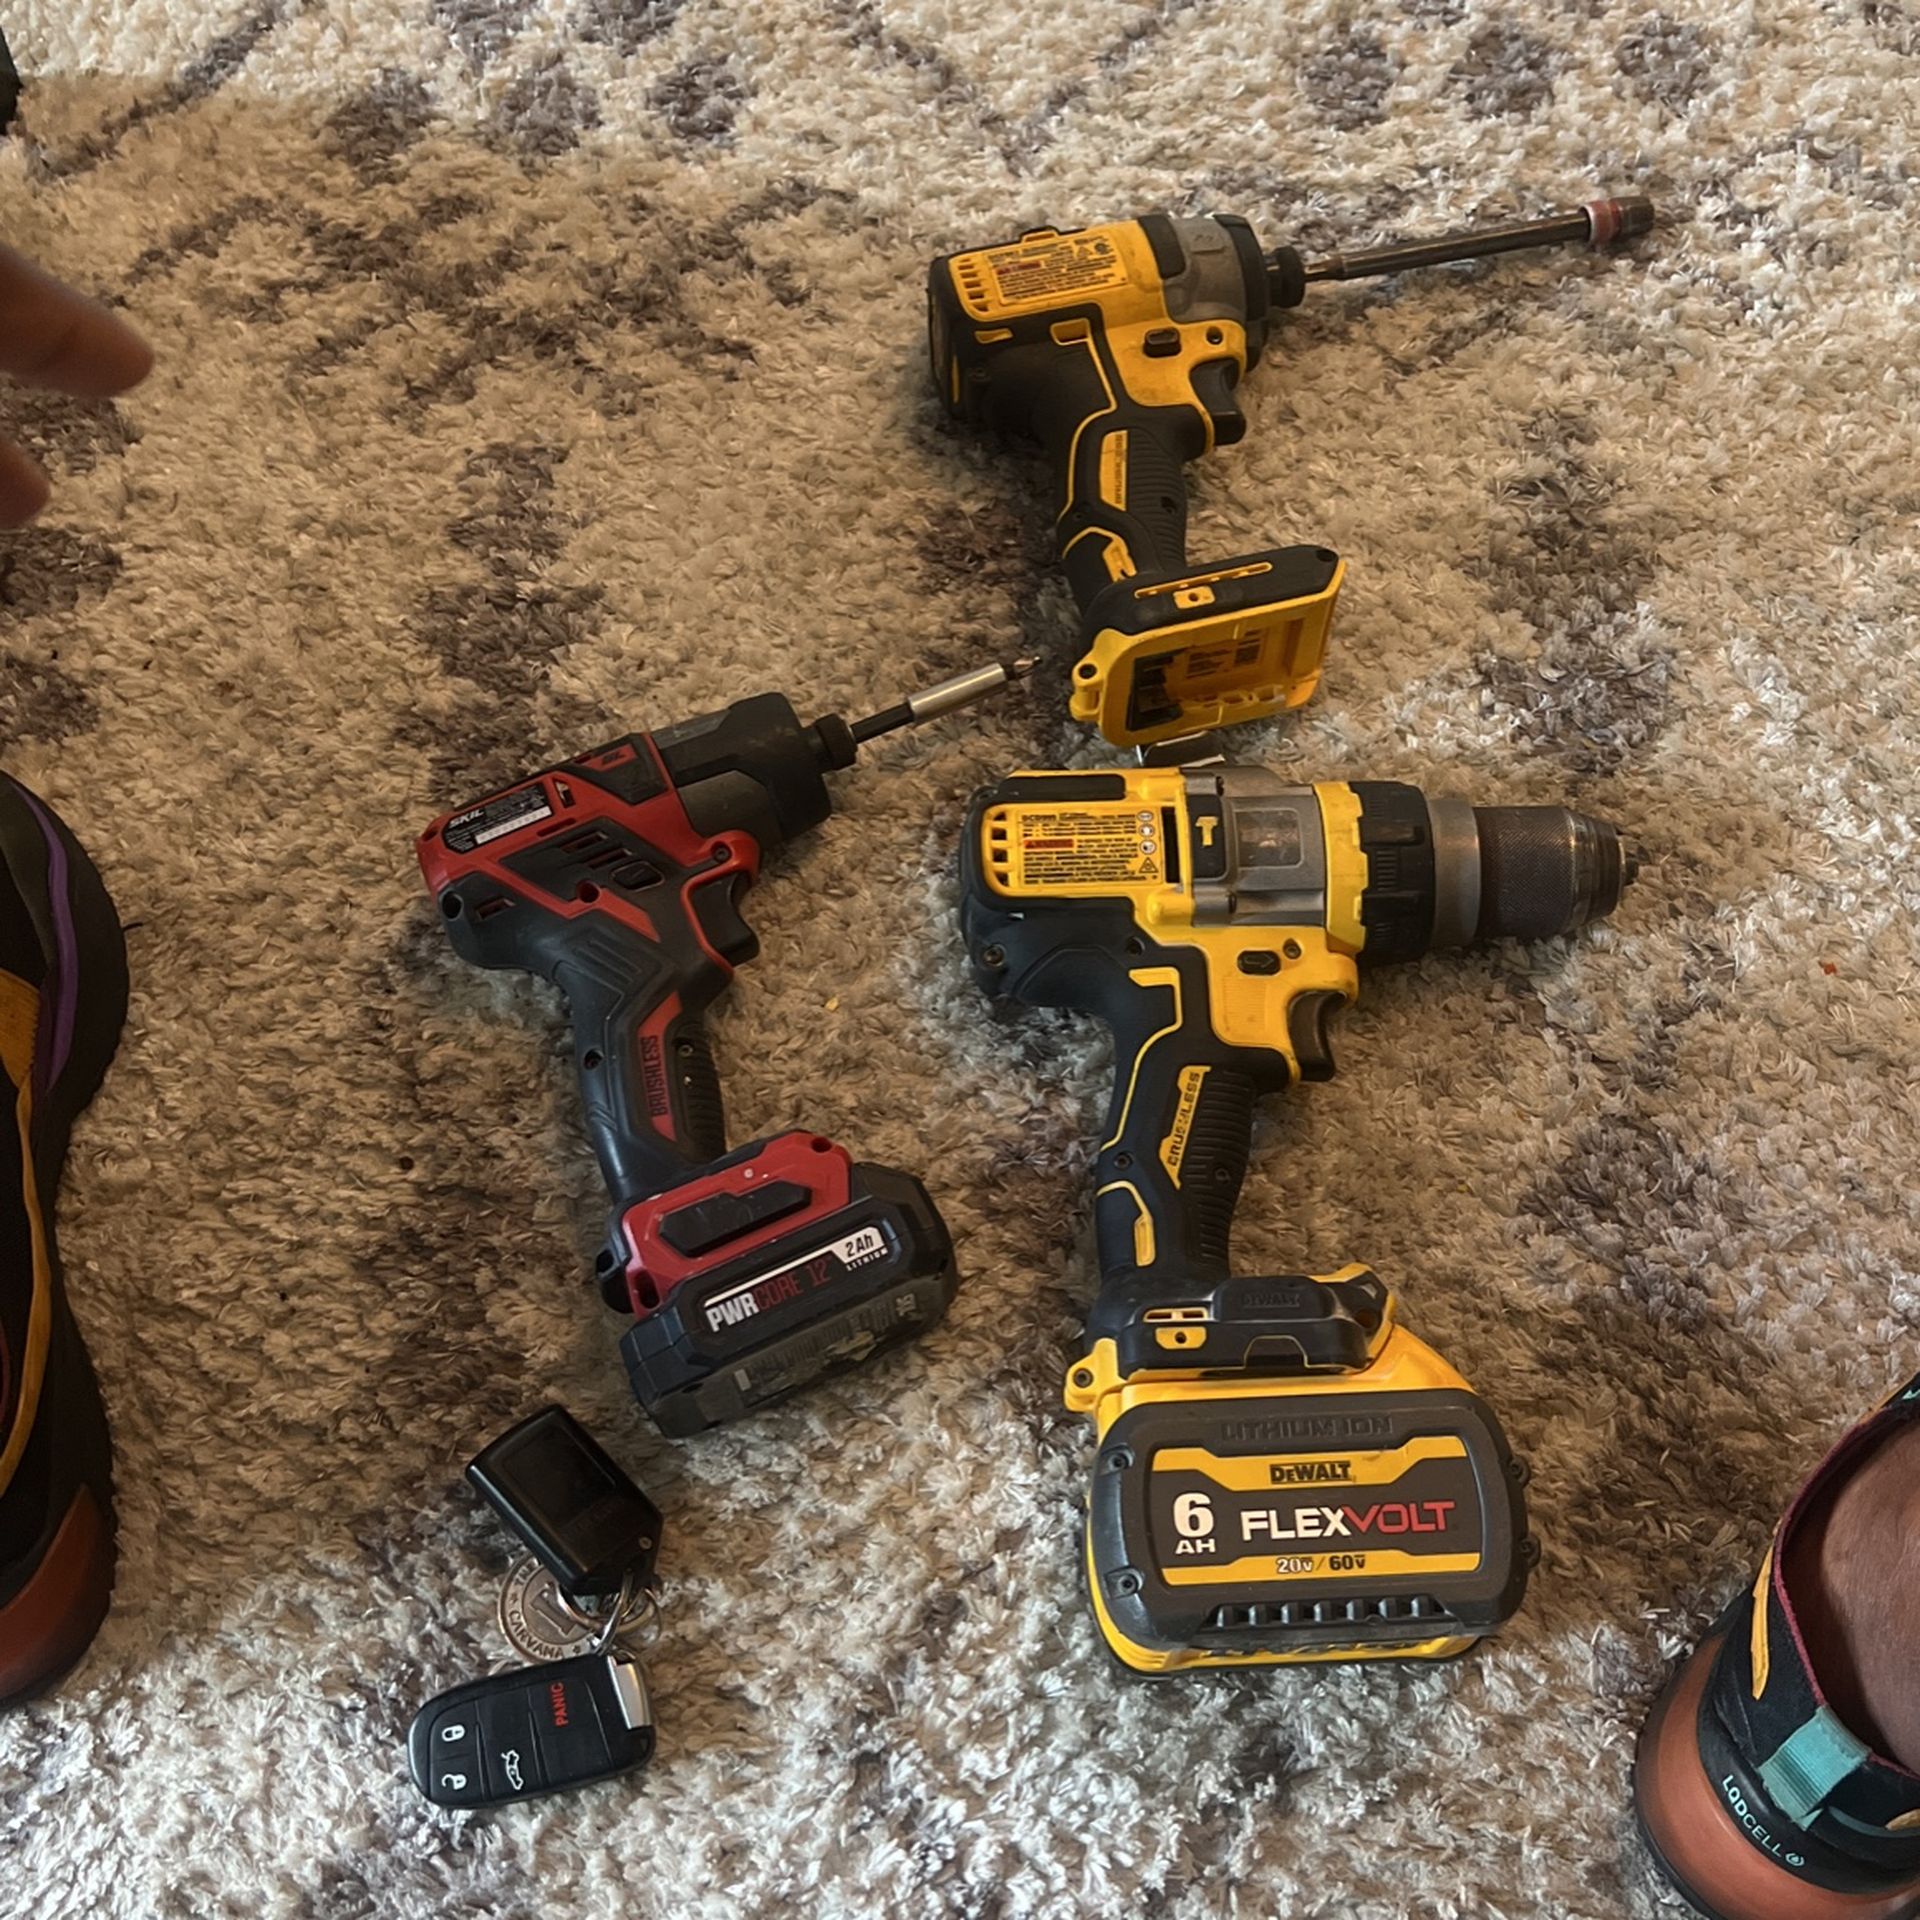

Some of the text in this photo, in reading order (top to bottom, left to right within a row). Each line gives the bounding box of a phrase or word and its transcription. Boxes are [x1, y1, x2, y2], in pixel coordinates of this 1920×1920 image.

[449, 809, 484, 829] SKIL
[641, 1035, 668, 1117] BRUSHLESS
[845, 1233, 874, 1258] 2Ah
[705, 1258, 832, 1333] PWRCORE 12
[1222, 1416, 1394, 1441] LITHIUM ION
[1172, 1492, 1215, 1538] 6
[1240, 1501, 1456, 1542] FLEXVOLT
[1175, 1538, 1217, 1555] AH
[508, 1609, 564, 1660] CARVANA
[551, 1681, 569, 1728] PANIC
[1722, 1774, 1782, 1858] LQDCELL
